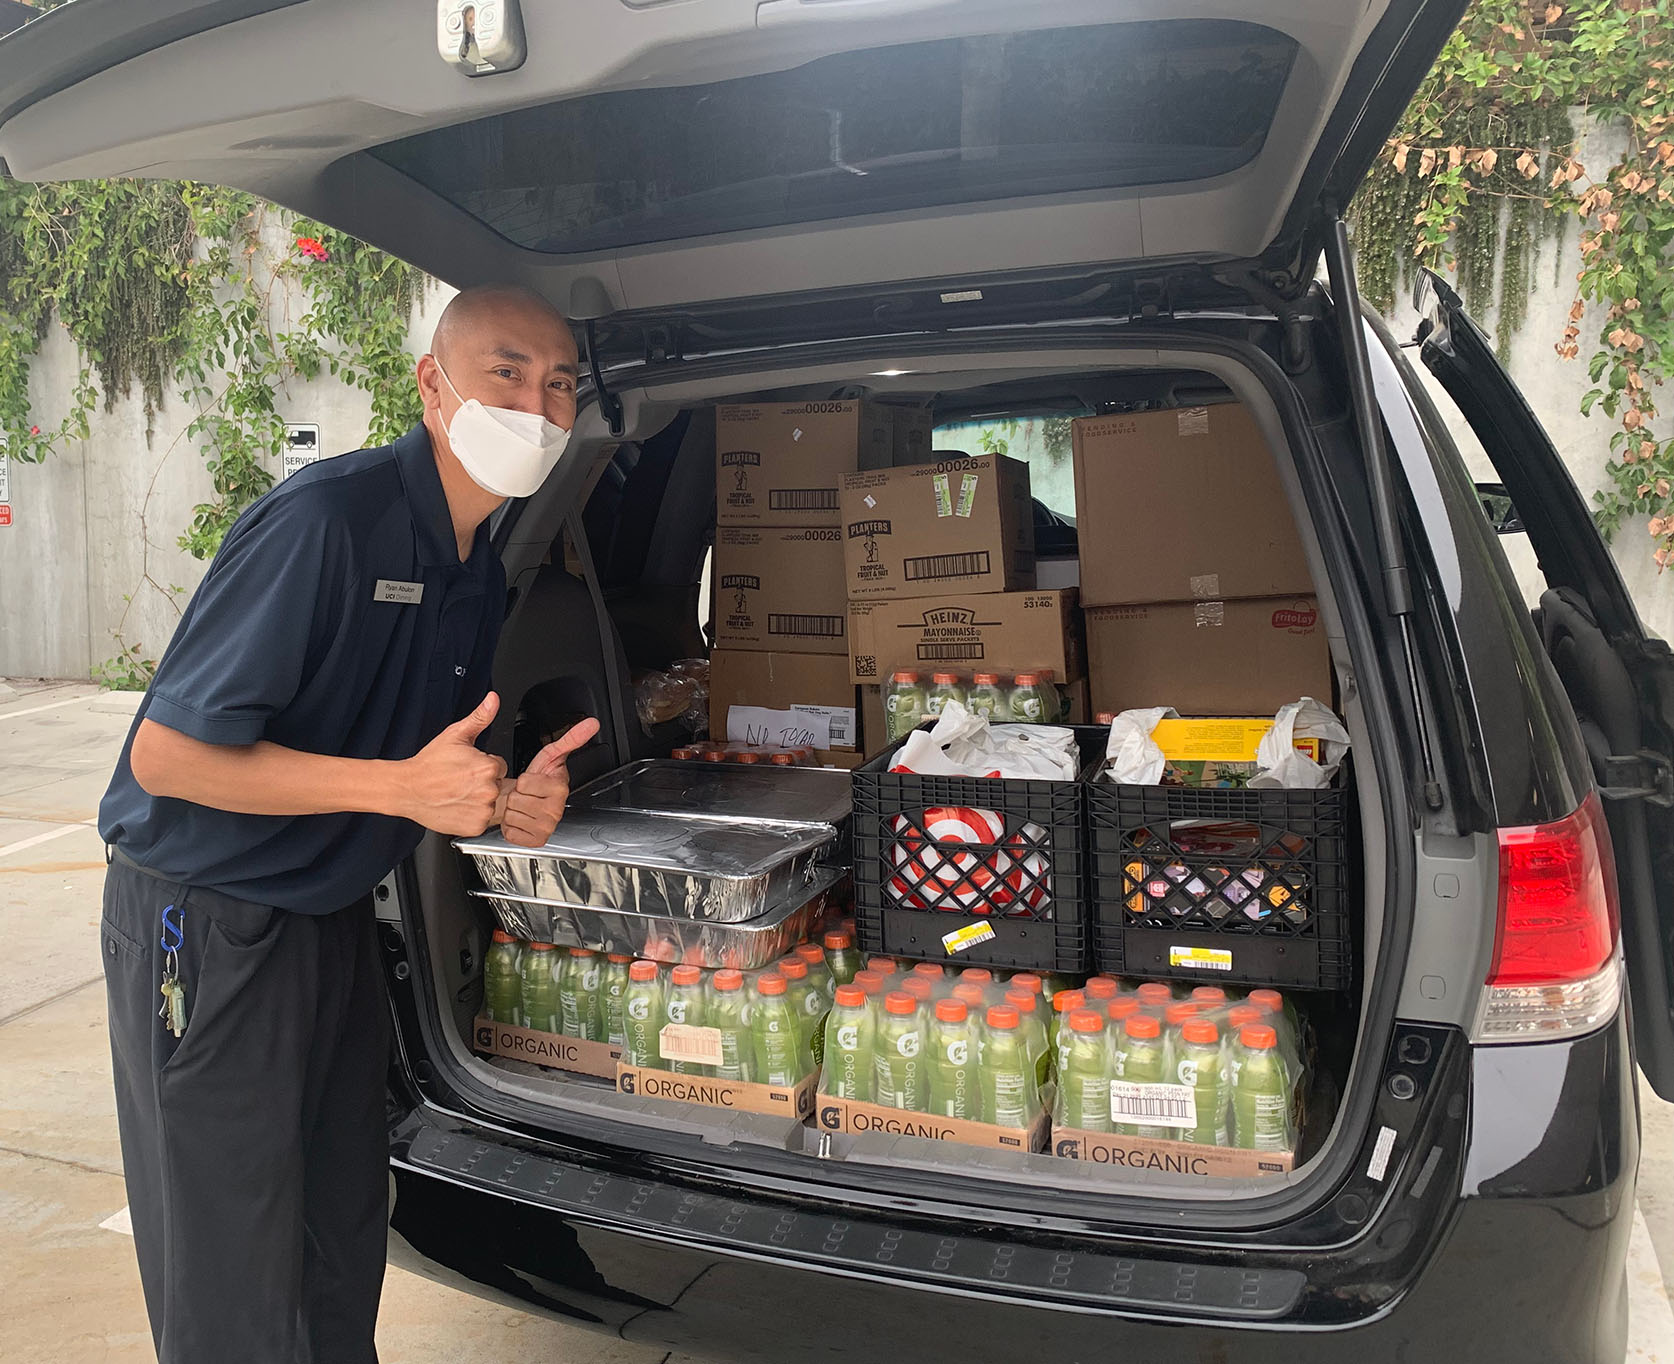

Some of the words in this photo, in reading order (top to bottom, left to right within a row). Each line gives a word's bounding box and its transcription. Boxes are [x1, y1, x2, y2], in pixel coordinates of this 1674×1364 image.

[849, 521, 889, 536] PLANTERS
[723, 576, 758, 588] PLANTERS
[923, 627, 976, 637] MAYONNAISE
[930, 611, 967, 625] HEINZ
[501, 1033, 578, 1062] ORGANIC
[634, 1023, 647, 1067] ORGANI
[843, 1054, 856, 1100] ORGANI
[645, 1078, 734, 1106] ORGANIC
[955, 1070, 966, 1120] ORGANI
[853, 1114, 956, 1141] ORGANIC
[1092, 1146, 1208, 1176] ORGANIC
